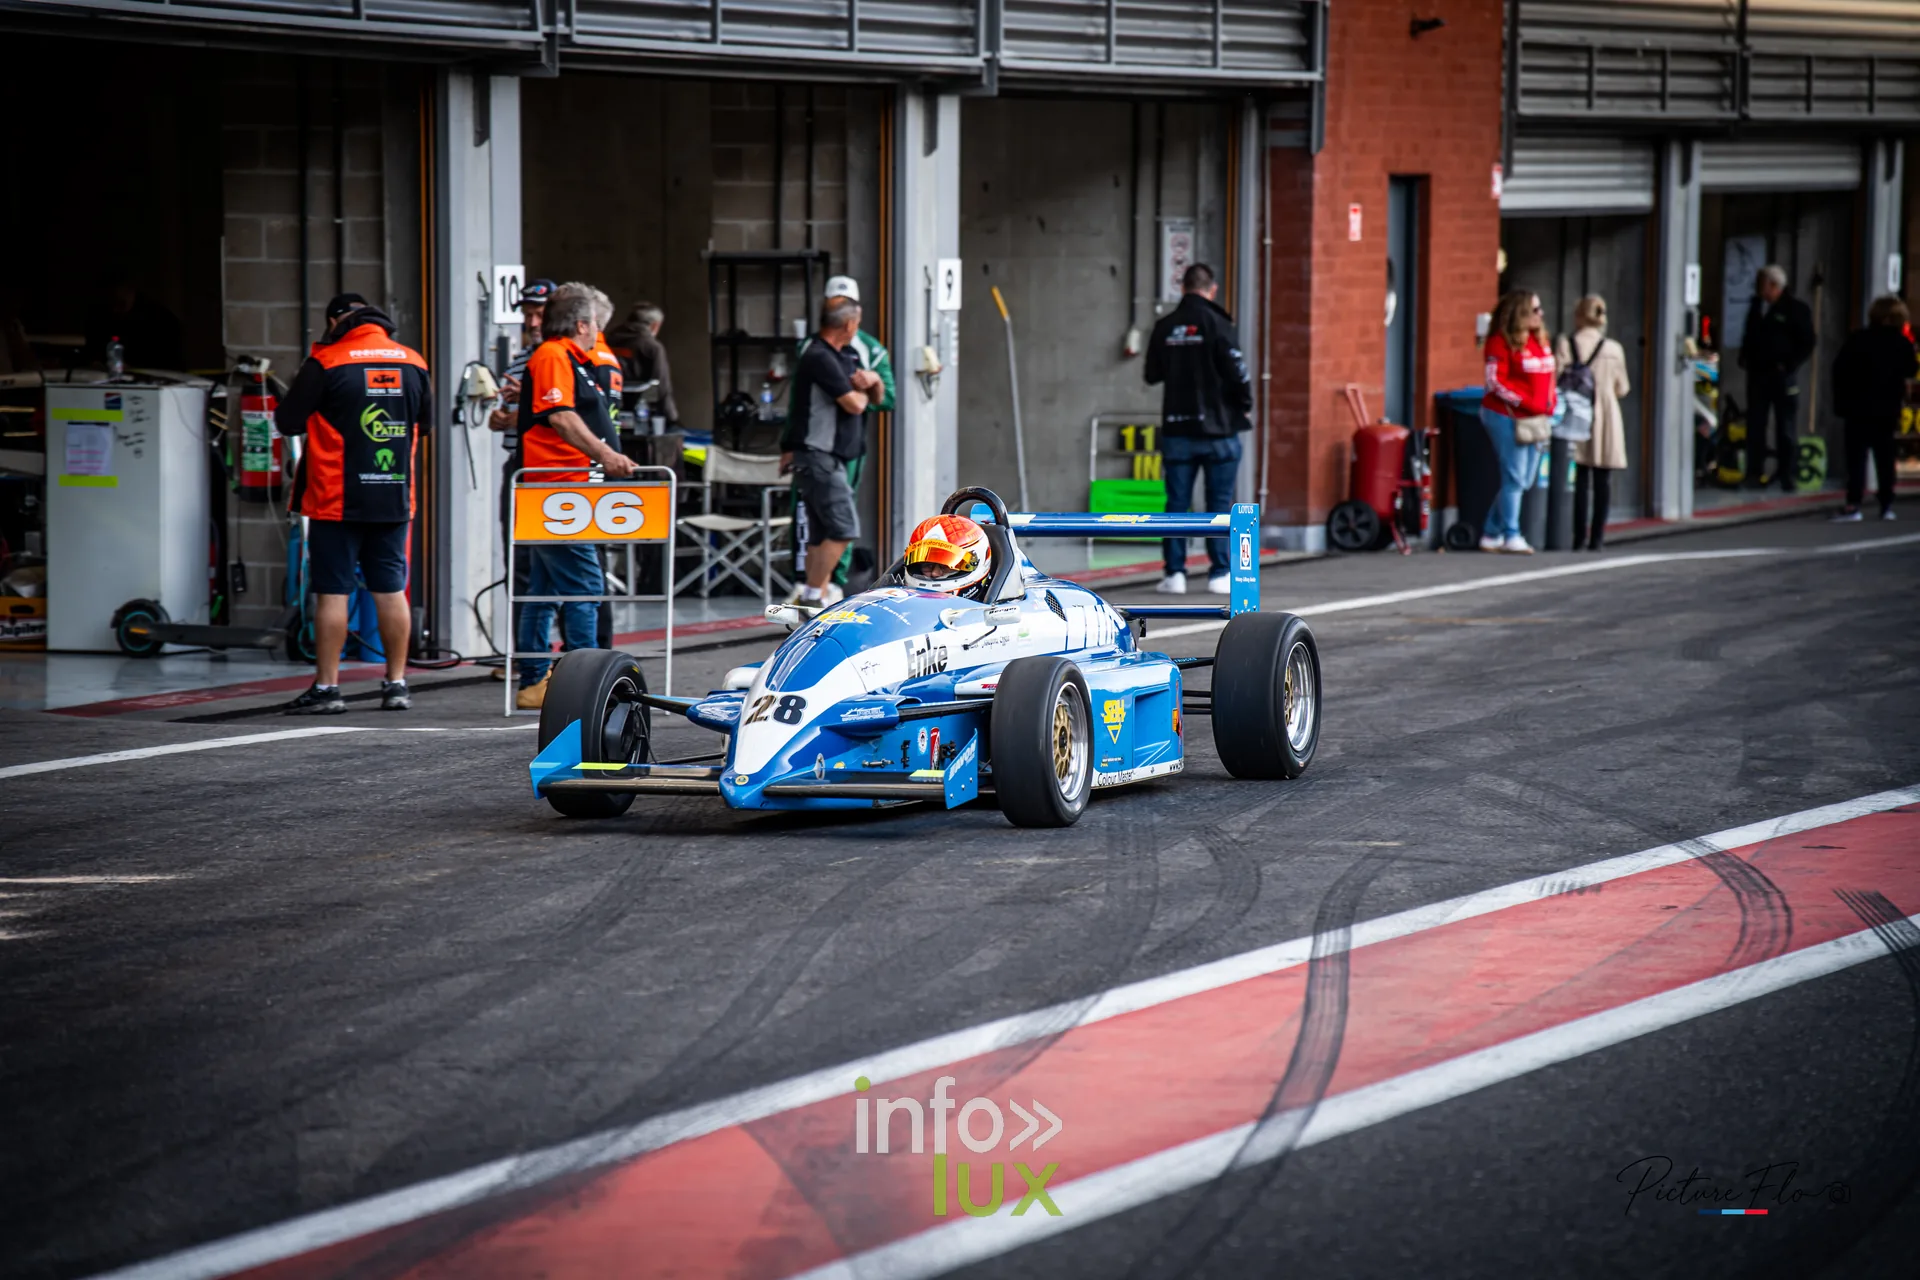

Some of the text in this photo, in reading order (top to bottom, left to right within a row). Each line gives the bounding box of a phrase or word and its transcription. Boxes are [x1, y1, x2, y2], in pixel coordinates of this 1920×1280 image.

[500, 275, 519, 313] 10
[946, 268, 954, 301] 9
[1121, 424, 1155, 452] 11
[542, 491, 645, 535] 96
[1238, 505, 1254, 514] LOTUS
[904, 633, 948, 680] Enke
[743, 694, 807, 725] 28
[1098, 769, 1133, 787] Colour Master
